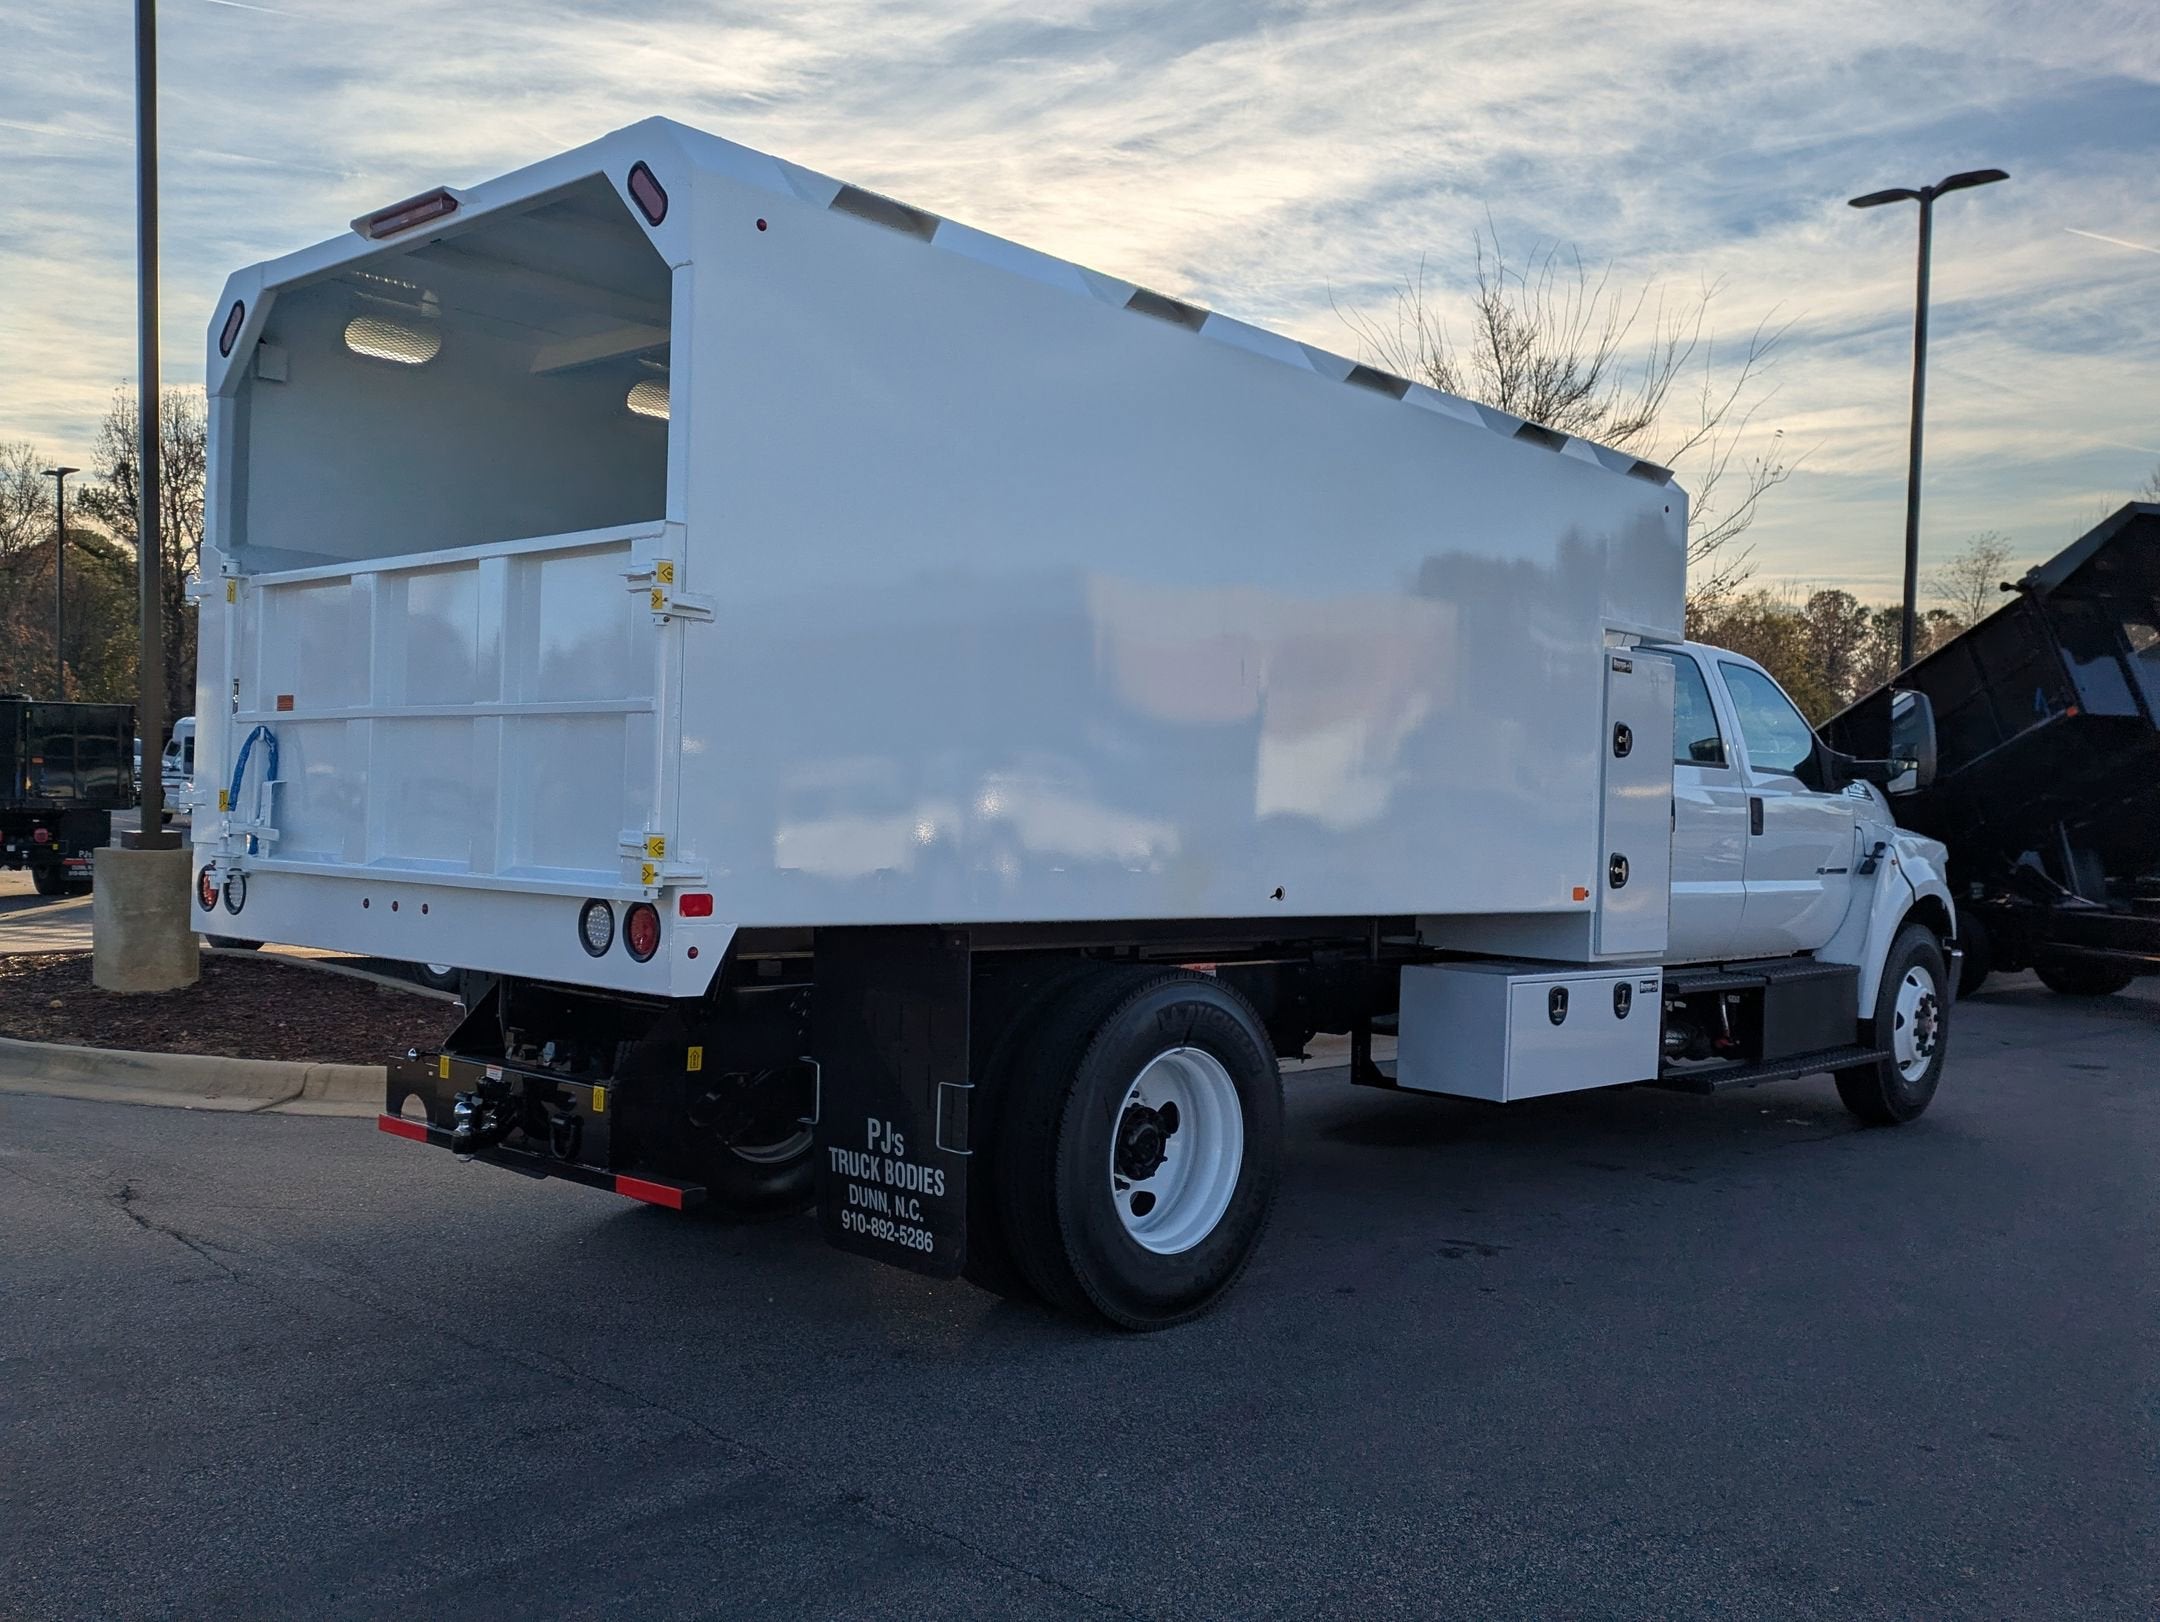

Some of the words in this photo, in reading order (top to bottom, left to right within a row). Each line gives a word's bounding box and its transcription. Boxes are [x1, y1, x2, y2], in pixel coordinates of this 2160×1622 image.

[867, 1117, 904, 1157] PJ's
[828, 1146, 881, 1183] TRUCK
[885, 1158, 945, 1197] BODIES
[848, 1183, 891, 1218] DUNN,
[895, 1195, 924, 1223] N.C.
[841, 1209, 934, 1253] 910-892-5286
